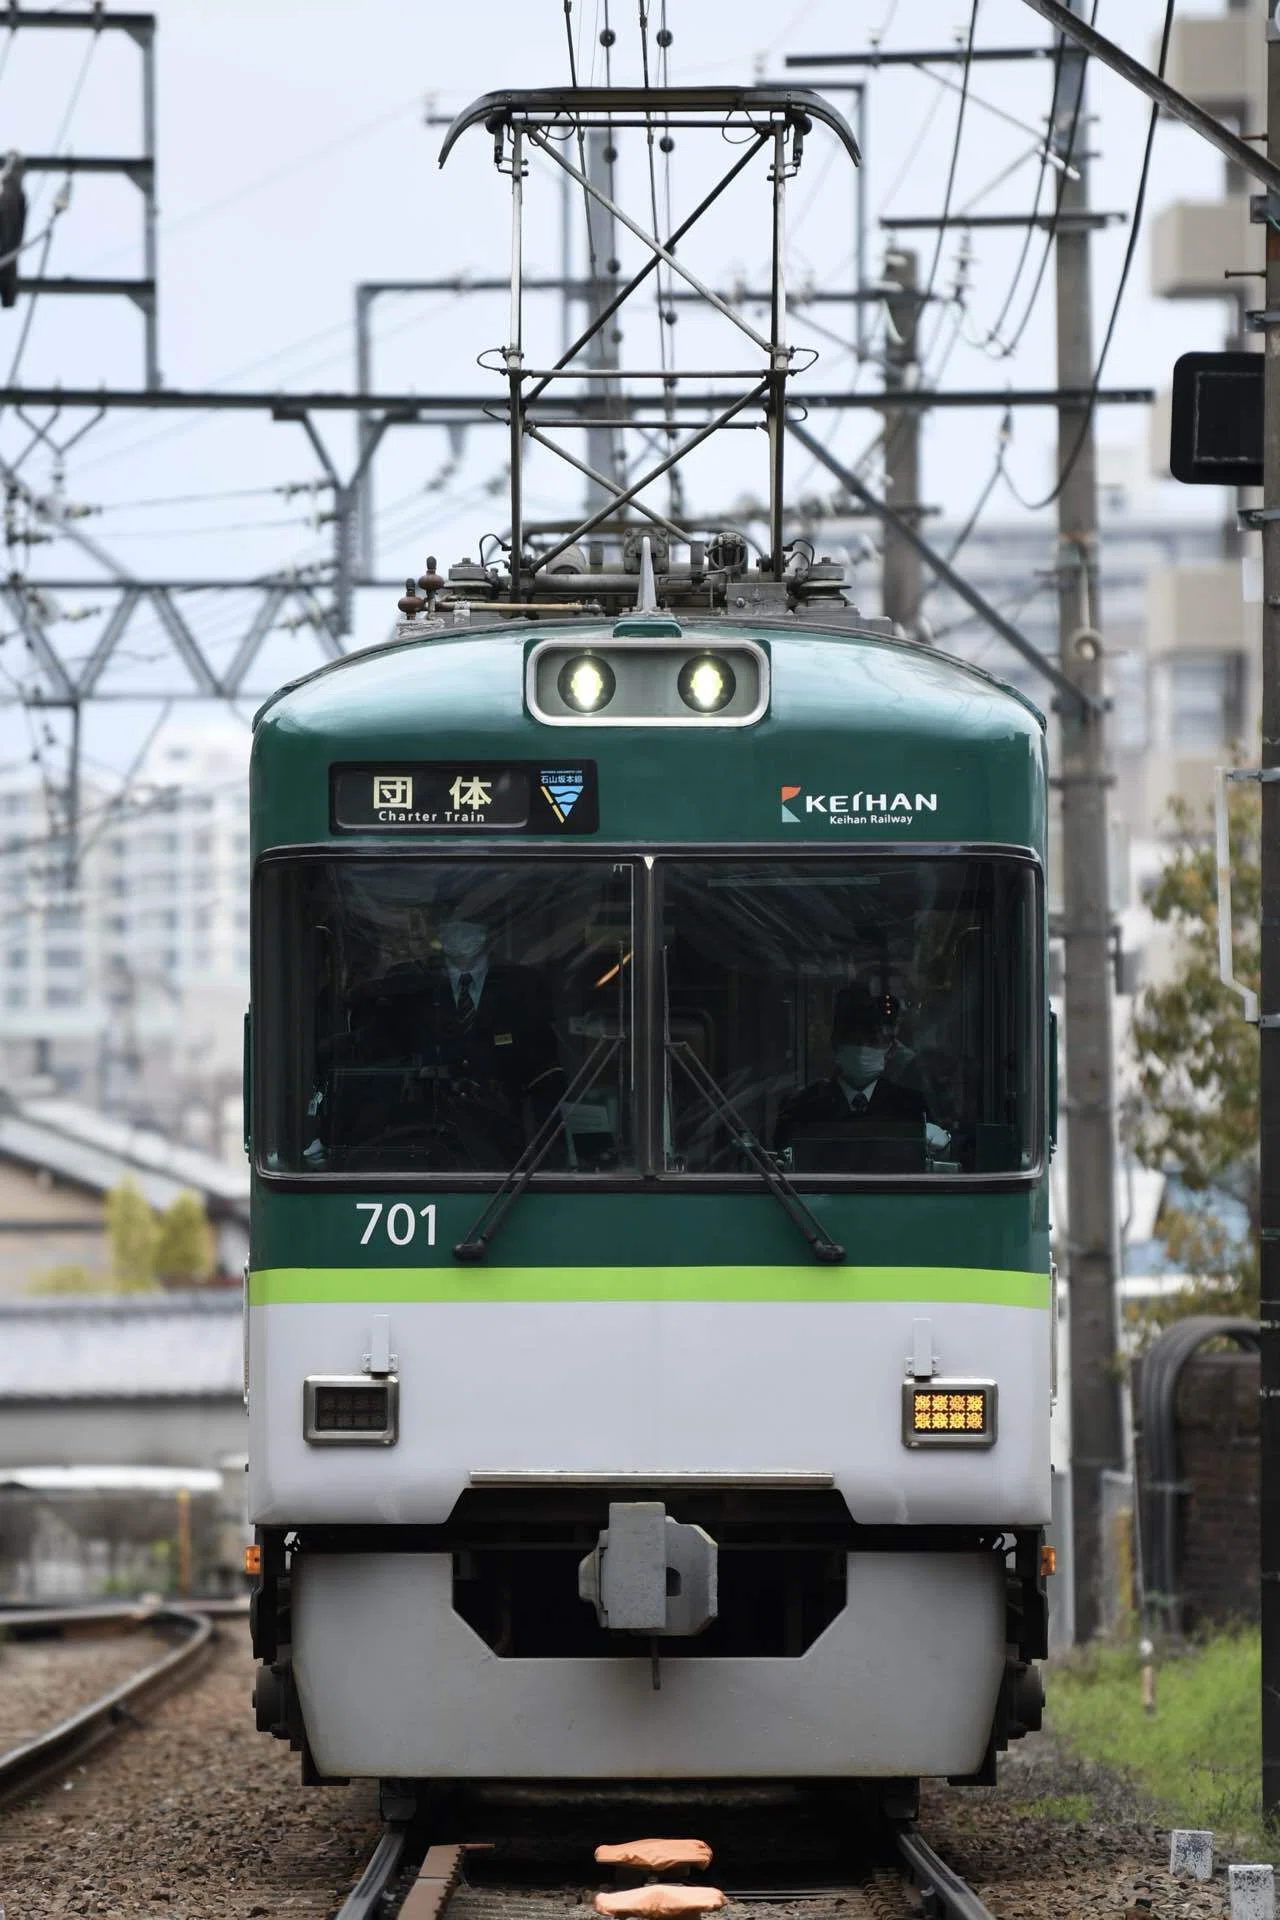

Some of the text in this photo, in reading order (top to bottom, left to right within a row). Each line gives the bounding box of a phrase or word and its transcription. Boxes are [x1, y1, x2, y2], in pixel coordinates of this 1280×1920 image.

[373, 776, 492, 810] 団体
[805, 791, 937, 813] KEIHAN
[378, 811, 485, 822] Charter Train
[830, 815, 913, 825] Keihan Railway
[356, 1203, 437, 1246] 701
